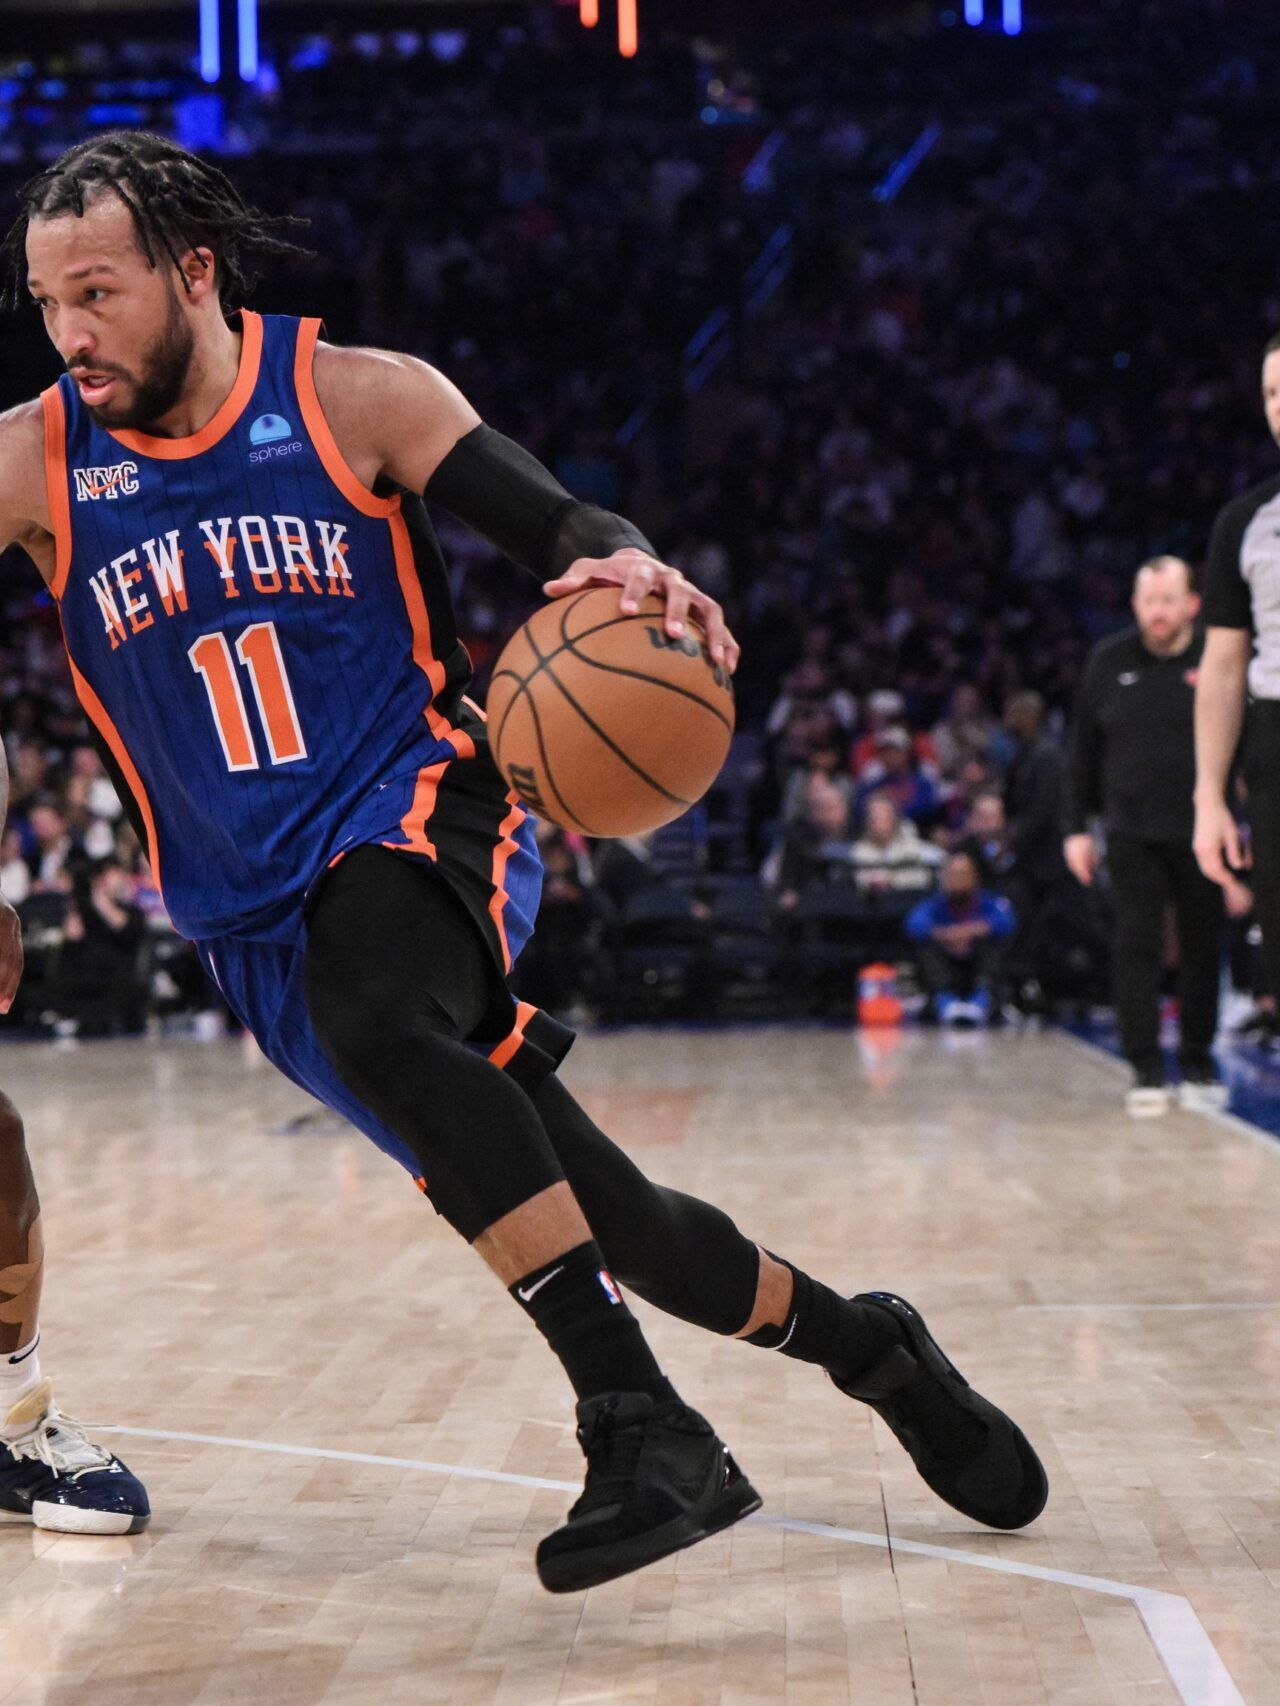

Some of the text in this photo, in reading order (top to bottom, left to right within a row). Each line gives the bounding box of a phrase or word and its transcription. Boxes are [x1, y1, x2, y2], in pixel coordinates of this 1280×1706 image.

[74, 461, 139, 501] NYC
[249, 440, 303, 463] sphere
[88, 514, 356, 650] NEW YORK
[187, 621, 308, 773] 11
